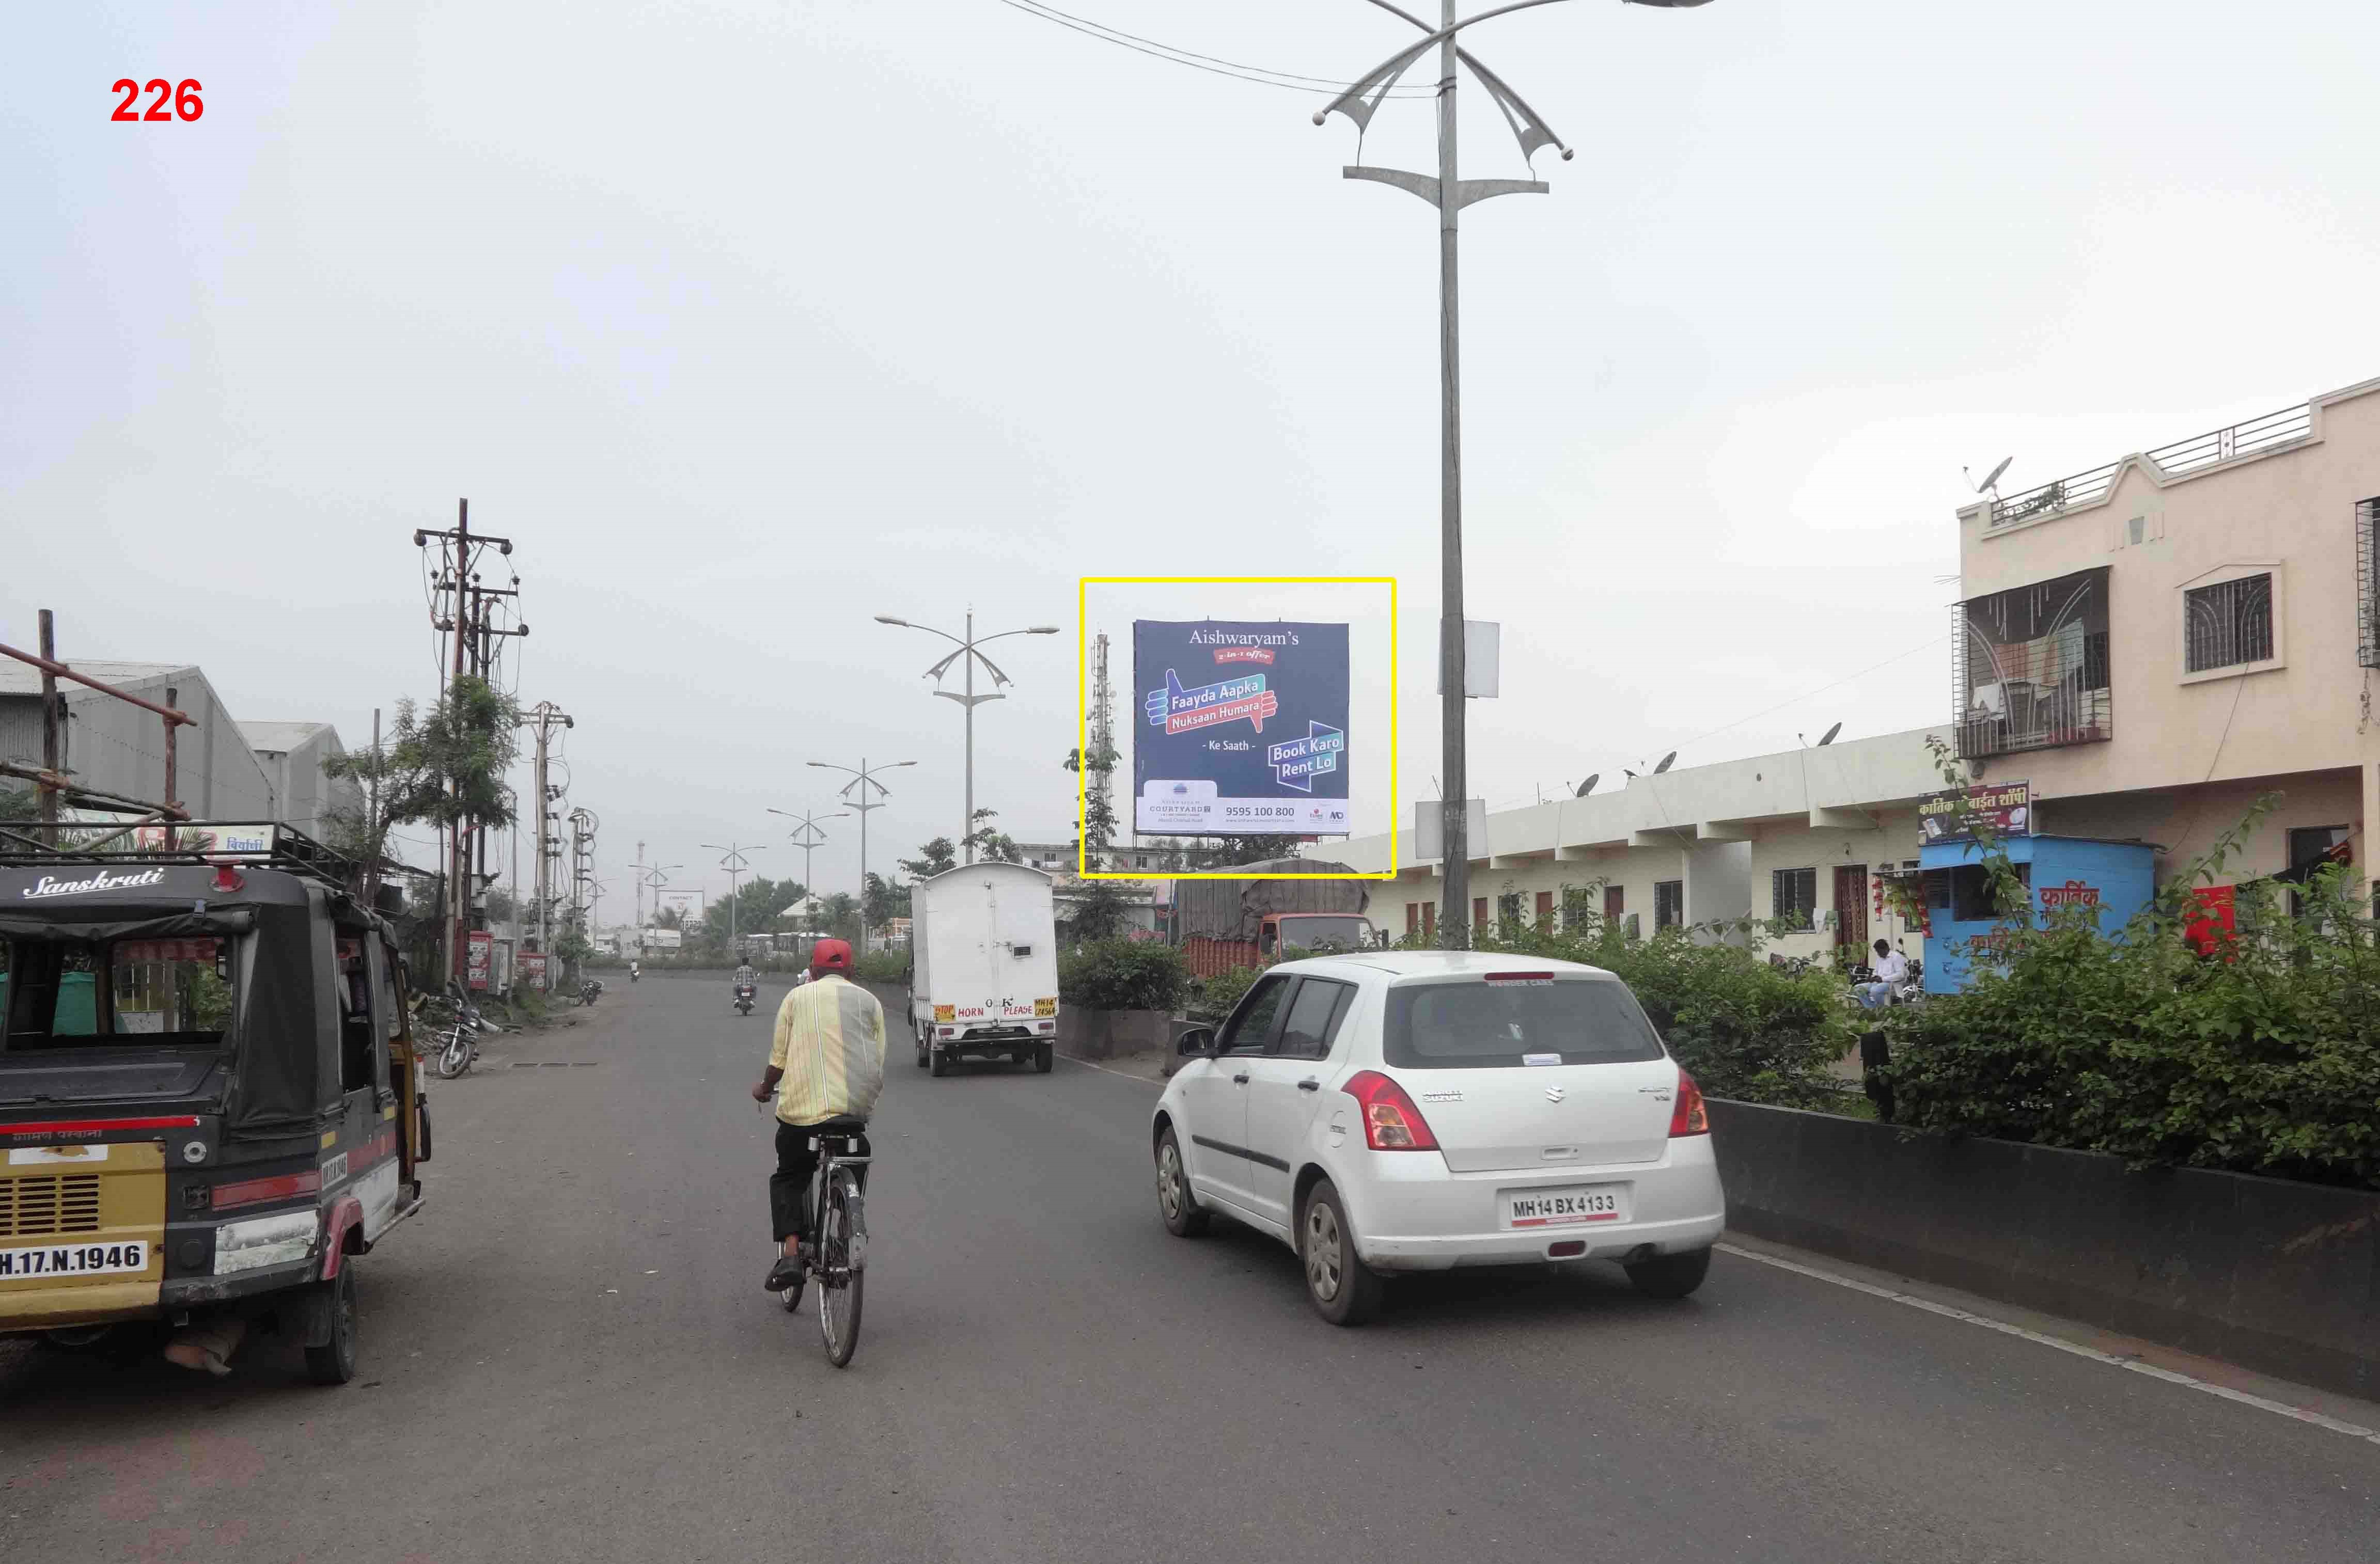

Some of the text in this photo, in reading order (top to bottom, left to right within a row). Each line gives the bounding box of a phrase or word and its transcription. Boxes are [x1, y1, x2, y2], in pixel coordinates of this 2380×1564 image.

[1188, 629, 1299, 648] Aishwaryam's
[1246, 651, 1271, 659] offer
[1171, 680, 1259, 710] Faayda Aapka
[1171, 702, 1260, 729] Nuksaan Humara
[1209, 740, 1248, 750] Ke Saath
[1274, 738, 1339, 761] Book Karo
[1282, 756, 1331, 777] Rent Lo
[1226, 807, 1295, 816] 9595 100 800
[22, 867, 164, 896] Sanskruti
[2039, 880, 2100, 906] कार्तिक
[958, 1005, 1032, 1017] HORN PLEASE
[1034, 999, 1054, 1007] MH14
[1513, 1195, 1615, 1217] MH14 BX 4133
